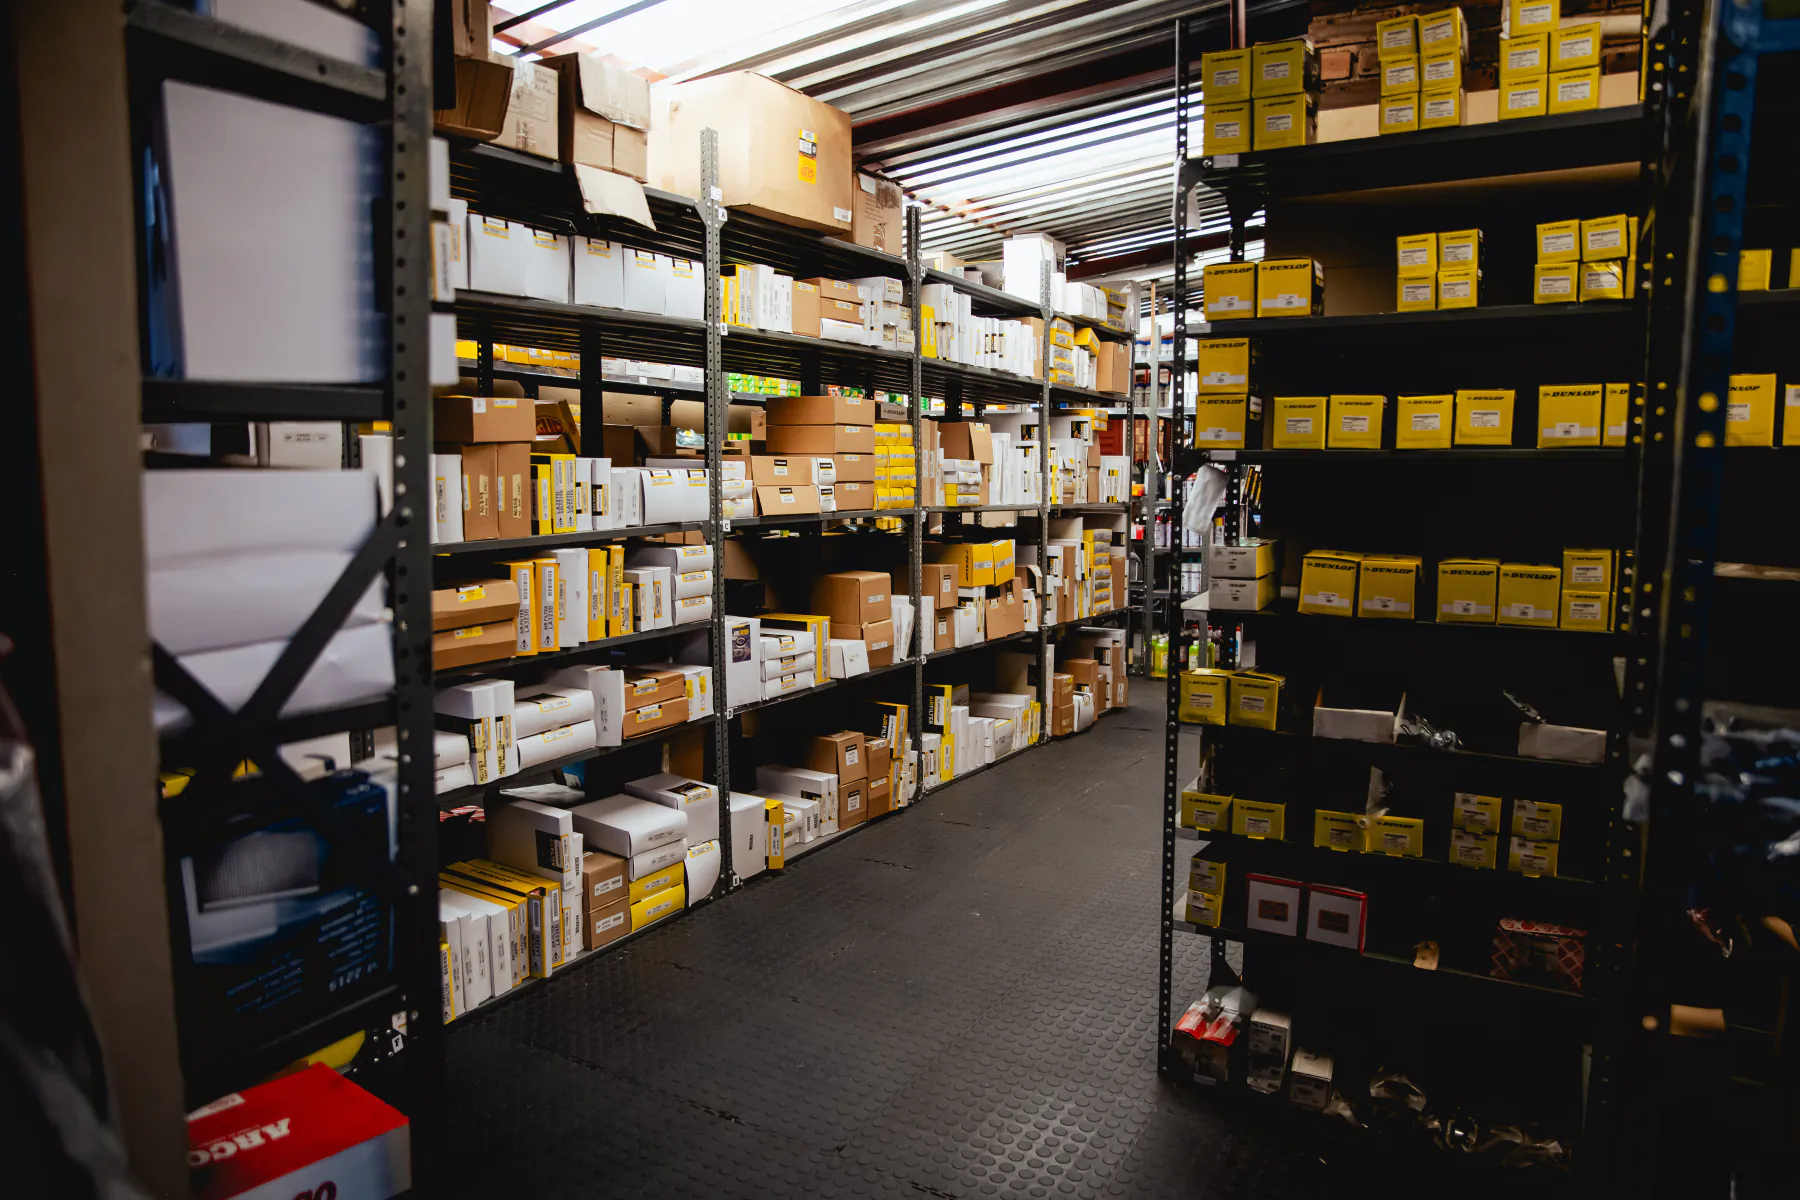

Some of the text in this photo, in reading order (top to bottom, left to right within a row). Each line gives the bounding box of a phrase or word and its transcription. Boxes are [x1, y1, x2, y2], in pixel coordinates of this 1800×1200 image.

[1213, 267, 1253, 276] DUNLOP
[1269, 263, 1309, 271] DUNLOP
[1314, 562, 1355, 571] DUNLOP
[1449, 569, 1495, 577] DUNLOP
[1510, 572, 1557, 580] DUNLOP
[394, 1037, 400, 1047] F
[188, 1117, 291, 1167] ARCO
